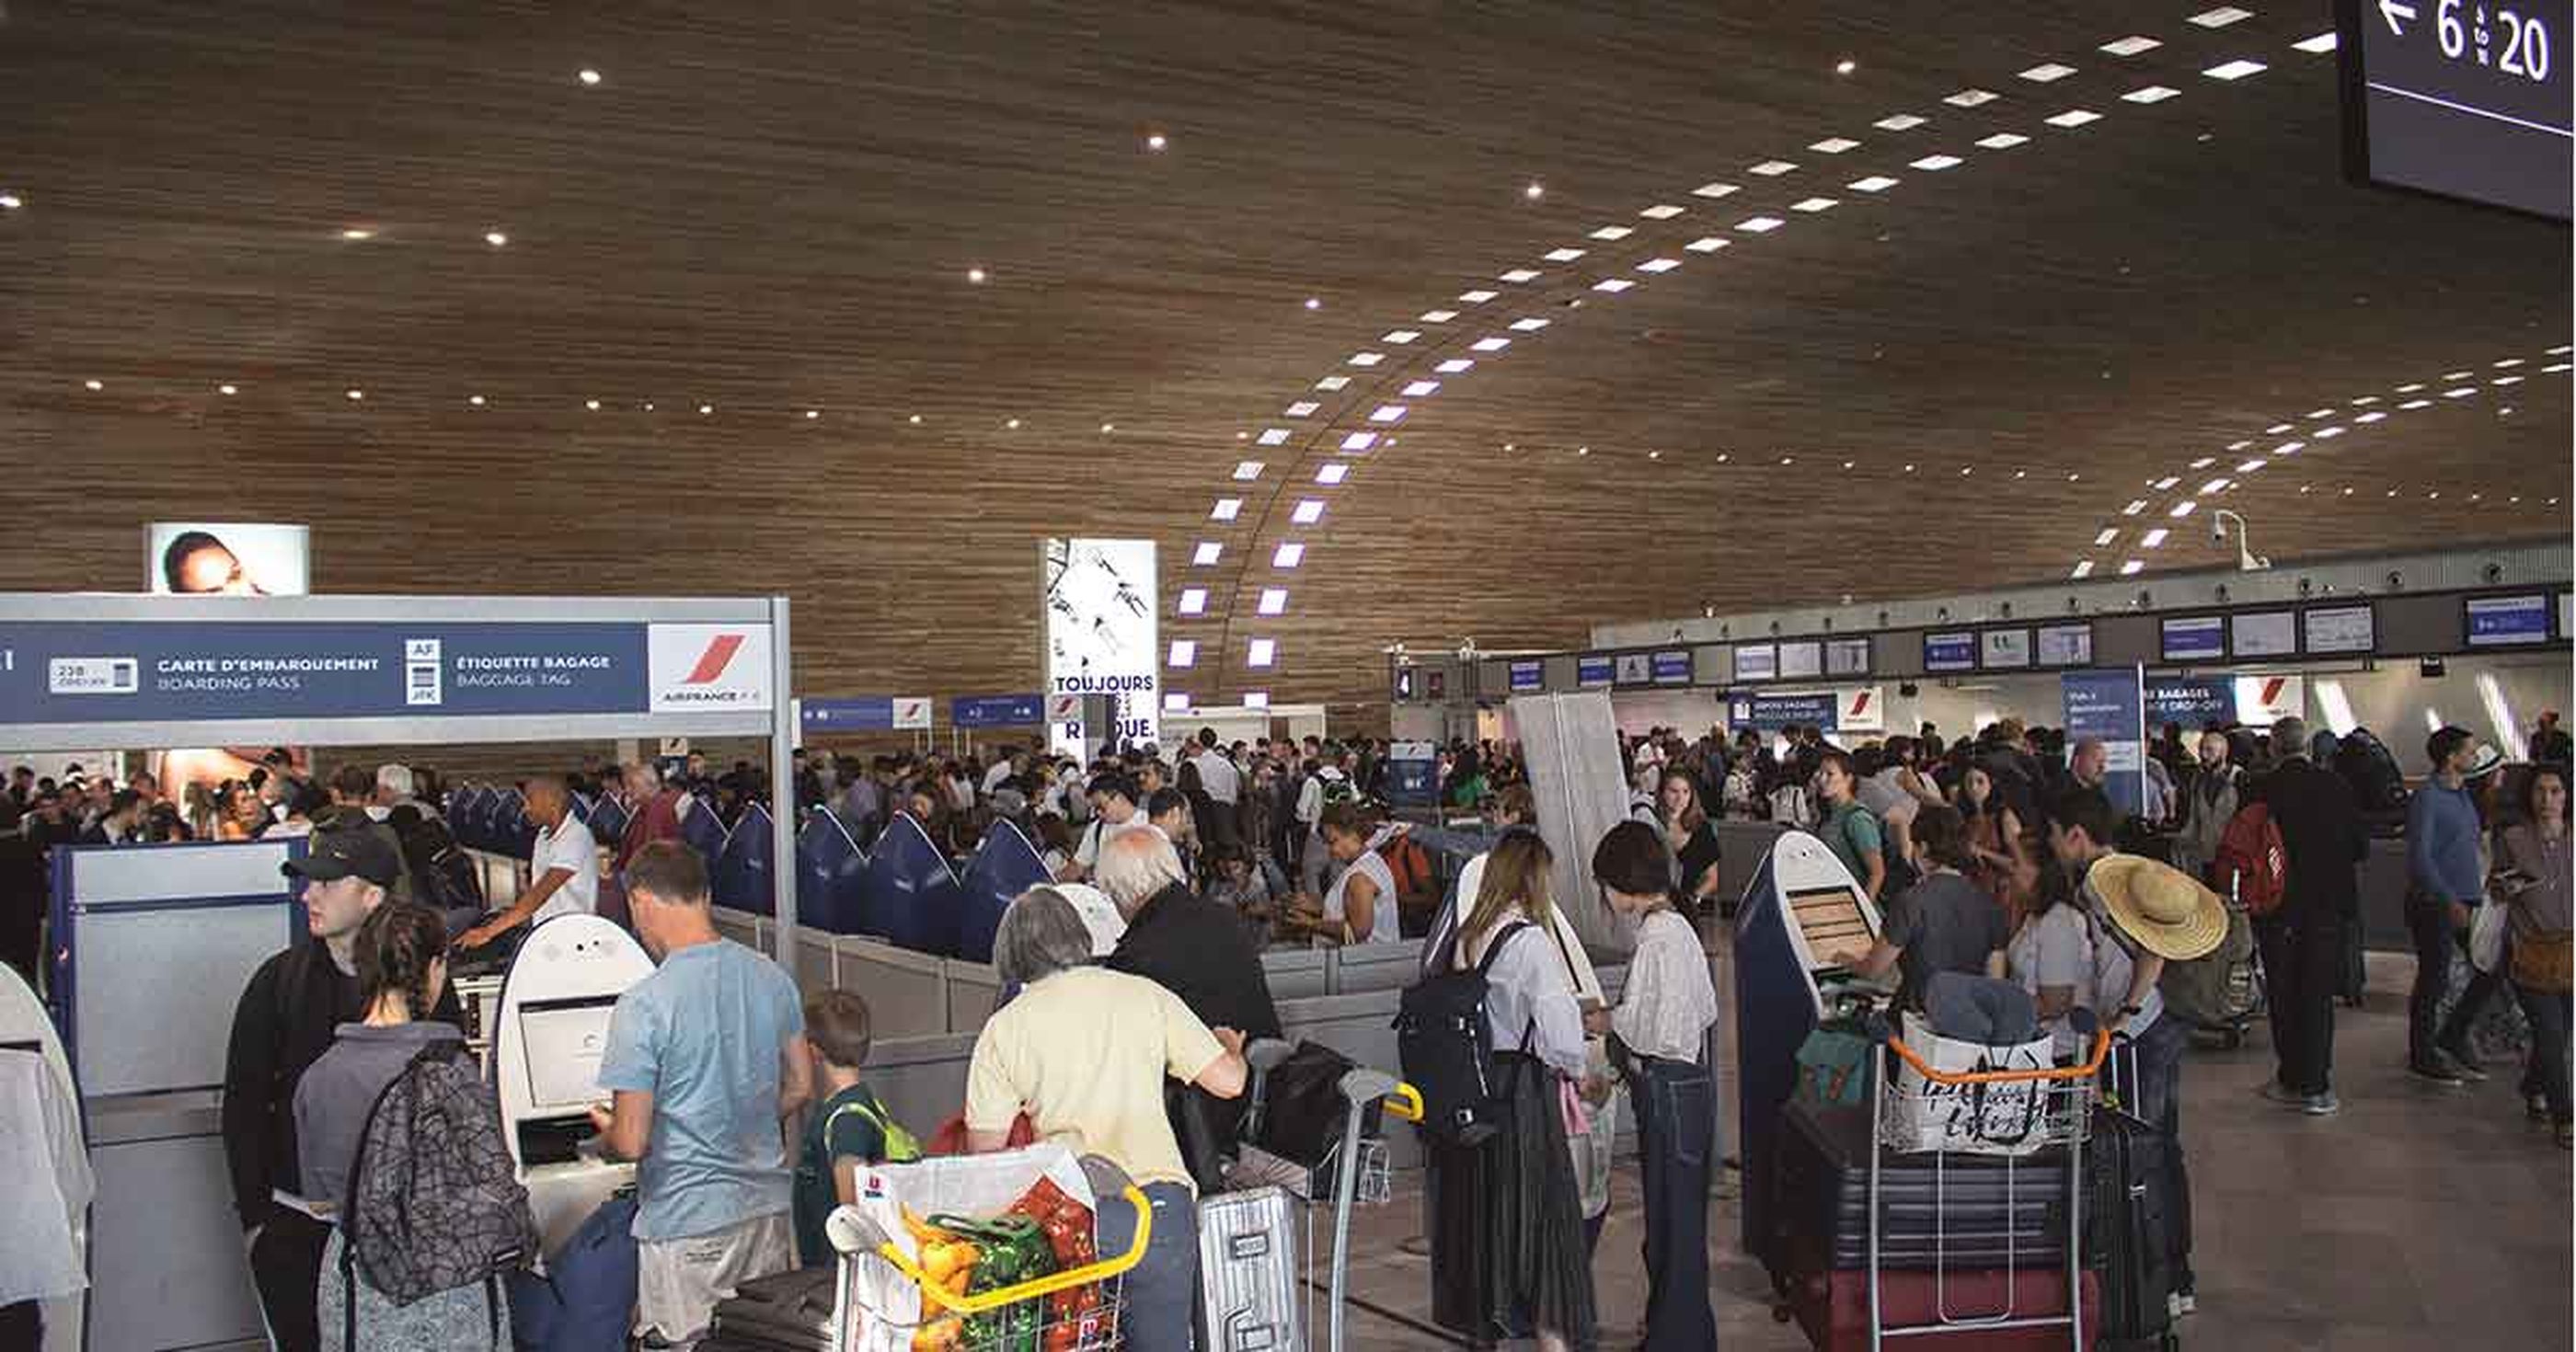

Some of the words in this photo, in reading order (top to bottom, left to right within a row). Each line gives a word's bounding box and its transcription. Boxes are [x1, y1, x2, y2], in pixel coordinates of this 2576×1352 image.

[2438, 0, 2464, 58] 6
[2498, 11, 2548, 80] 20
[415, 643, 434, 656] AF
[157, 659, 216, 672] CARTE
[222, 658, 379, 671] D'EMBARQUEMENT
[544, 657, 610, 669] BAGAGE
[157, 677, 251, 690] BOARDING
[257, 675, 302, 689] PASS
[456, 674, 534, 688] BAGGAGE
[541, 673, 571, 686] TAG
[1054, 675, 1154, 692] TOUJOURS
